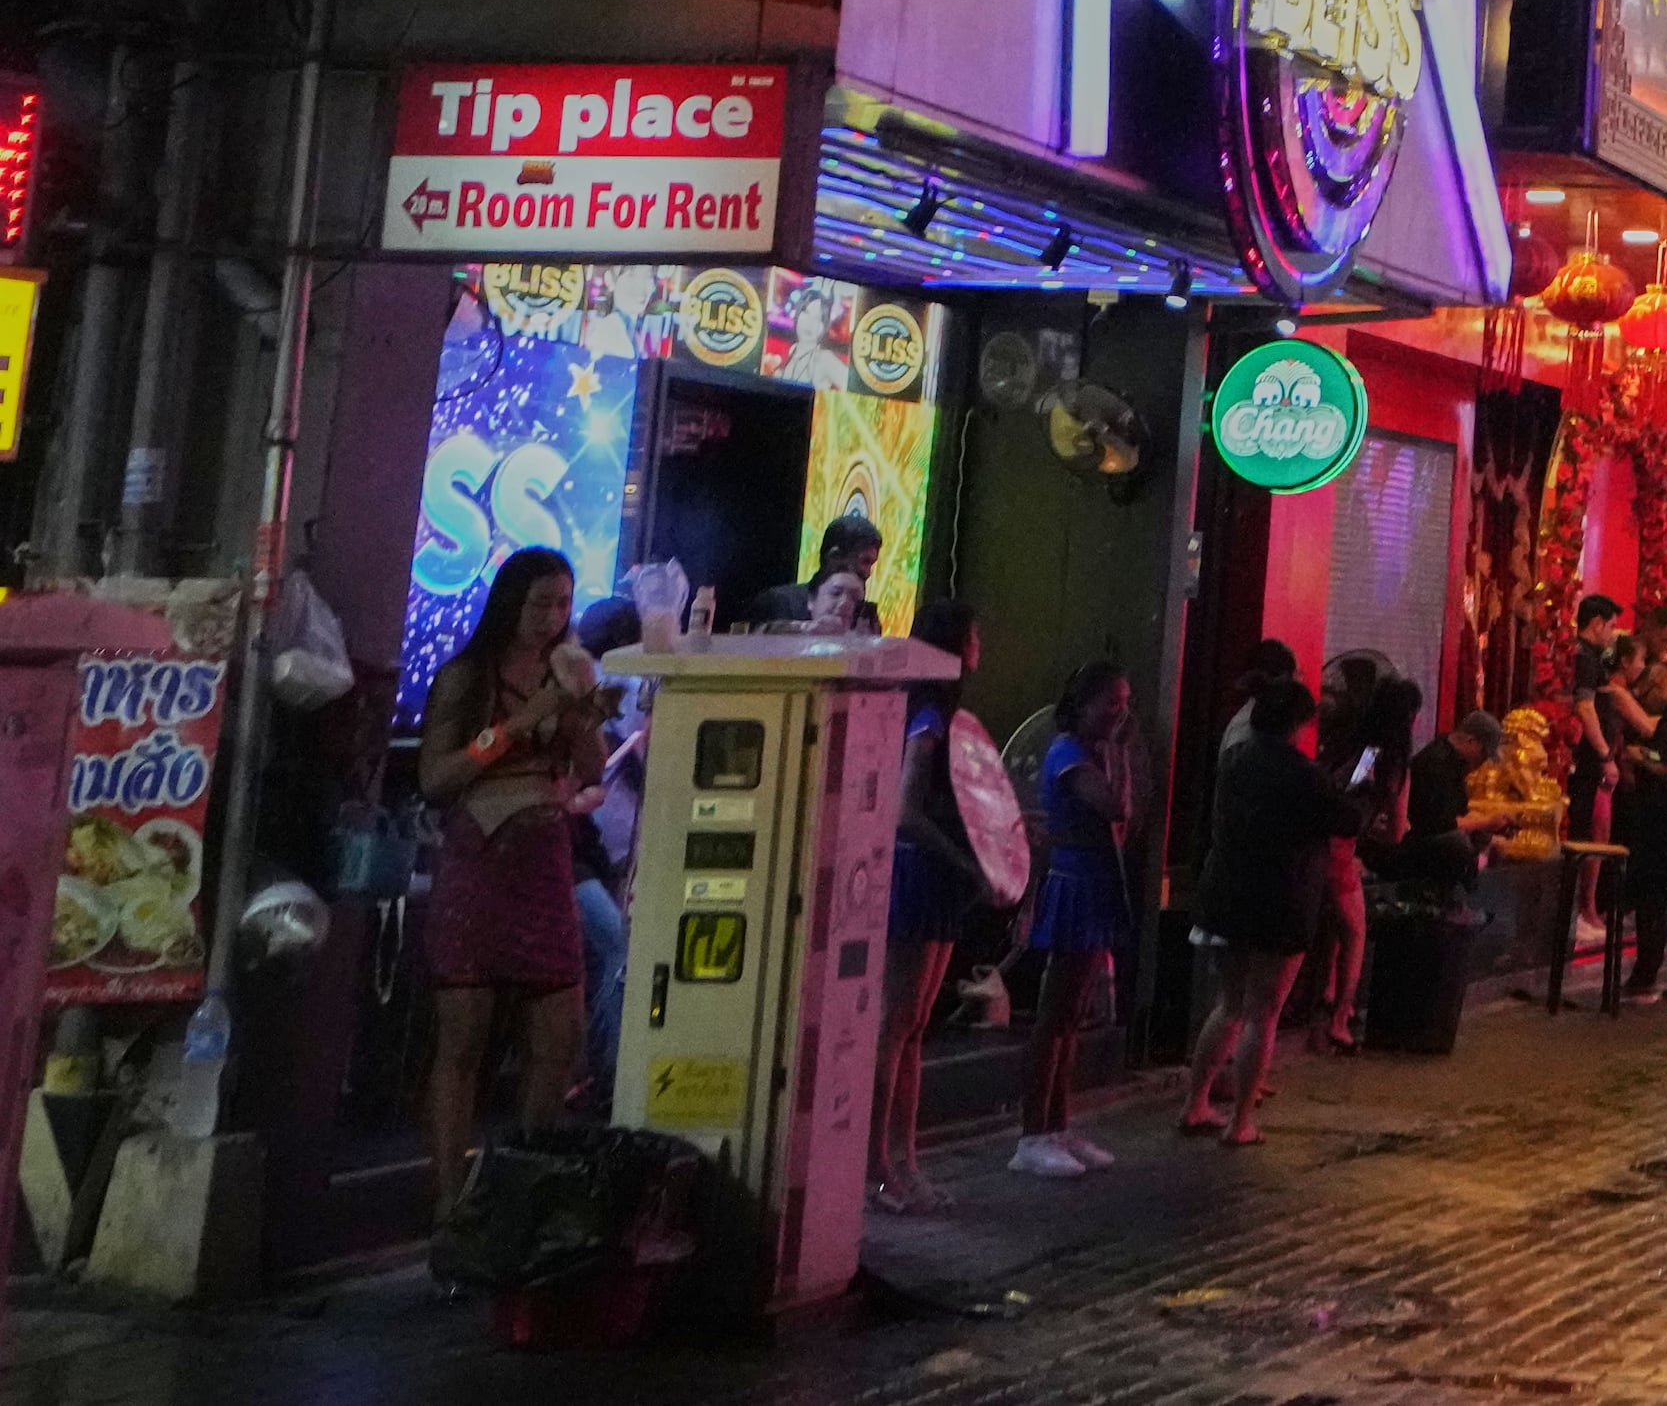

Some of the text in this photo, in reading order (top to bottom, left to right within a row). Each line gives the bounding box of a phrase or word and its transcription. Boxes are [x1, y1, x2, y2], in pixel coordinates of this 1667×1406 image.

[430, 77, 754, 154] Tip place
[455, 182, 574, 229] Room
[585, 182, 658, 229] For
[664, 181, 762, 231] Rent
[685, 297, 762, 333] BLISS
[858, 329, 921, 367] BLISS
[1228, 406, 1338, 450] Chang
